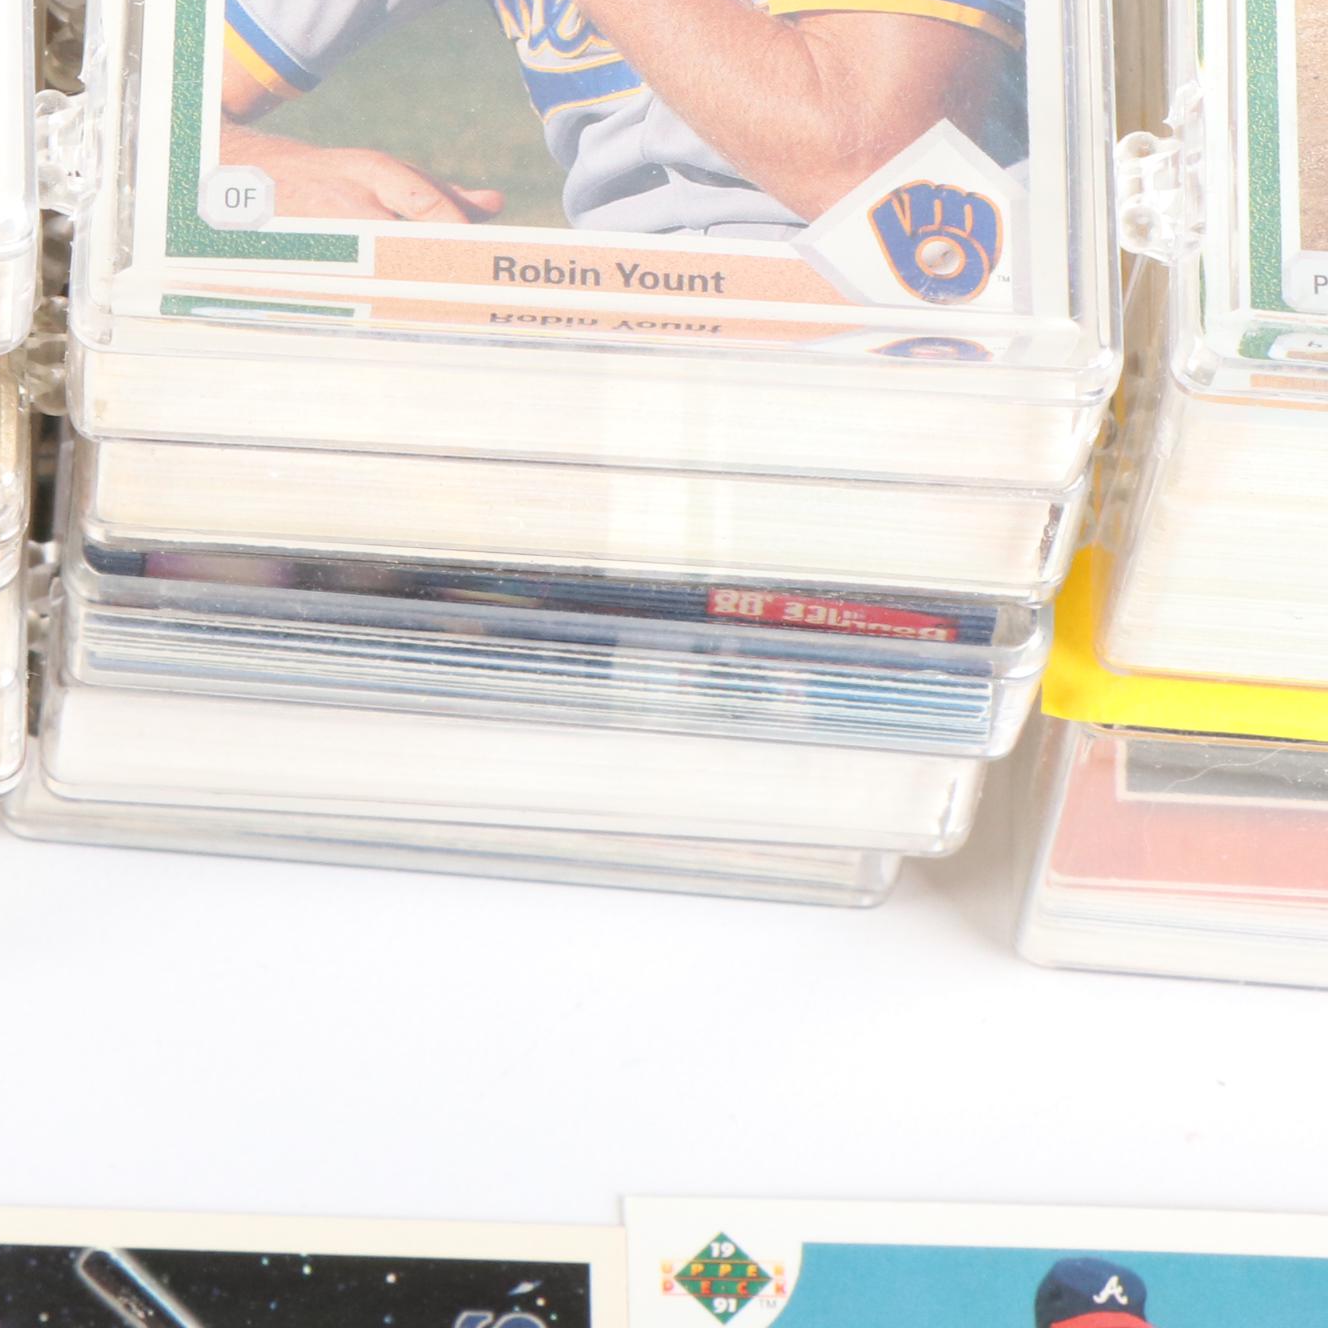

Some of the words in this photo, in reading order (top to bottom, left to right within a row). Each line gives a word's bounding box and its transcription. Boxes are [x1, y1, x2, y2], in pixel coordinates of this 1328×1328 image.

[223, 186, 258, 209] OF
[492, 255, 602, 287] Robin
[615, 262, 726, 294] Yount
[710, 1241, 737, 1259] 19
[712, 1296, 739, 1314] 91
